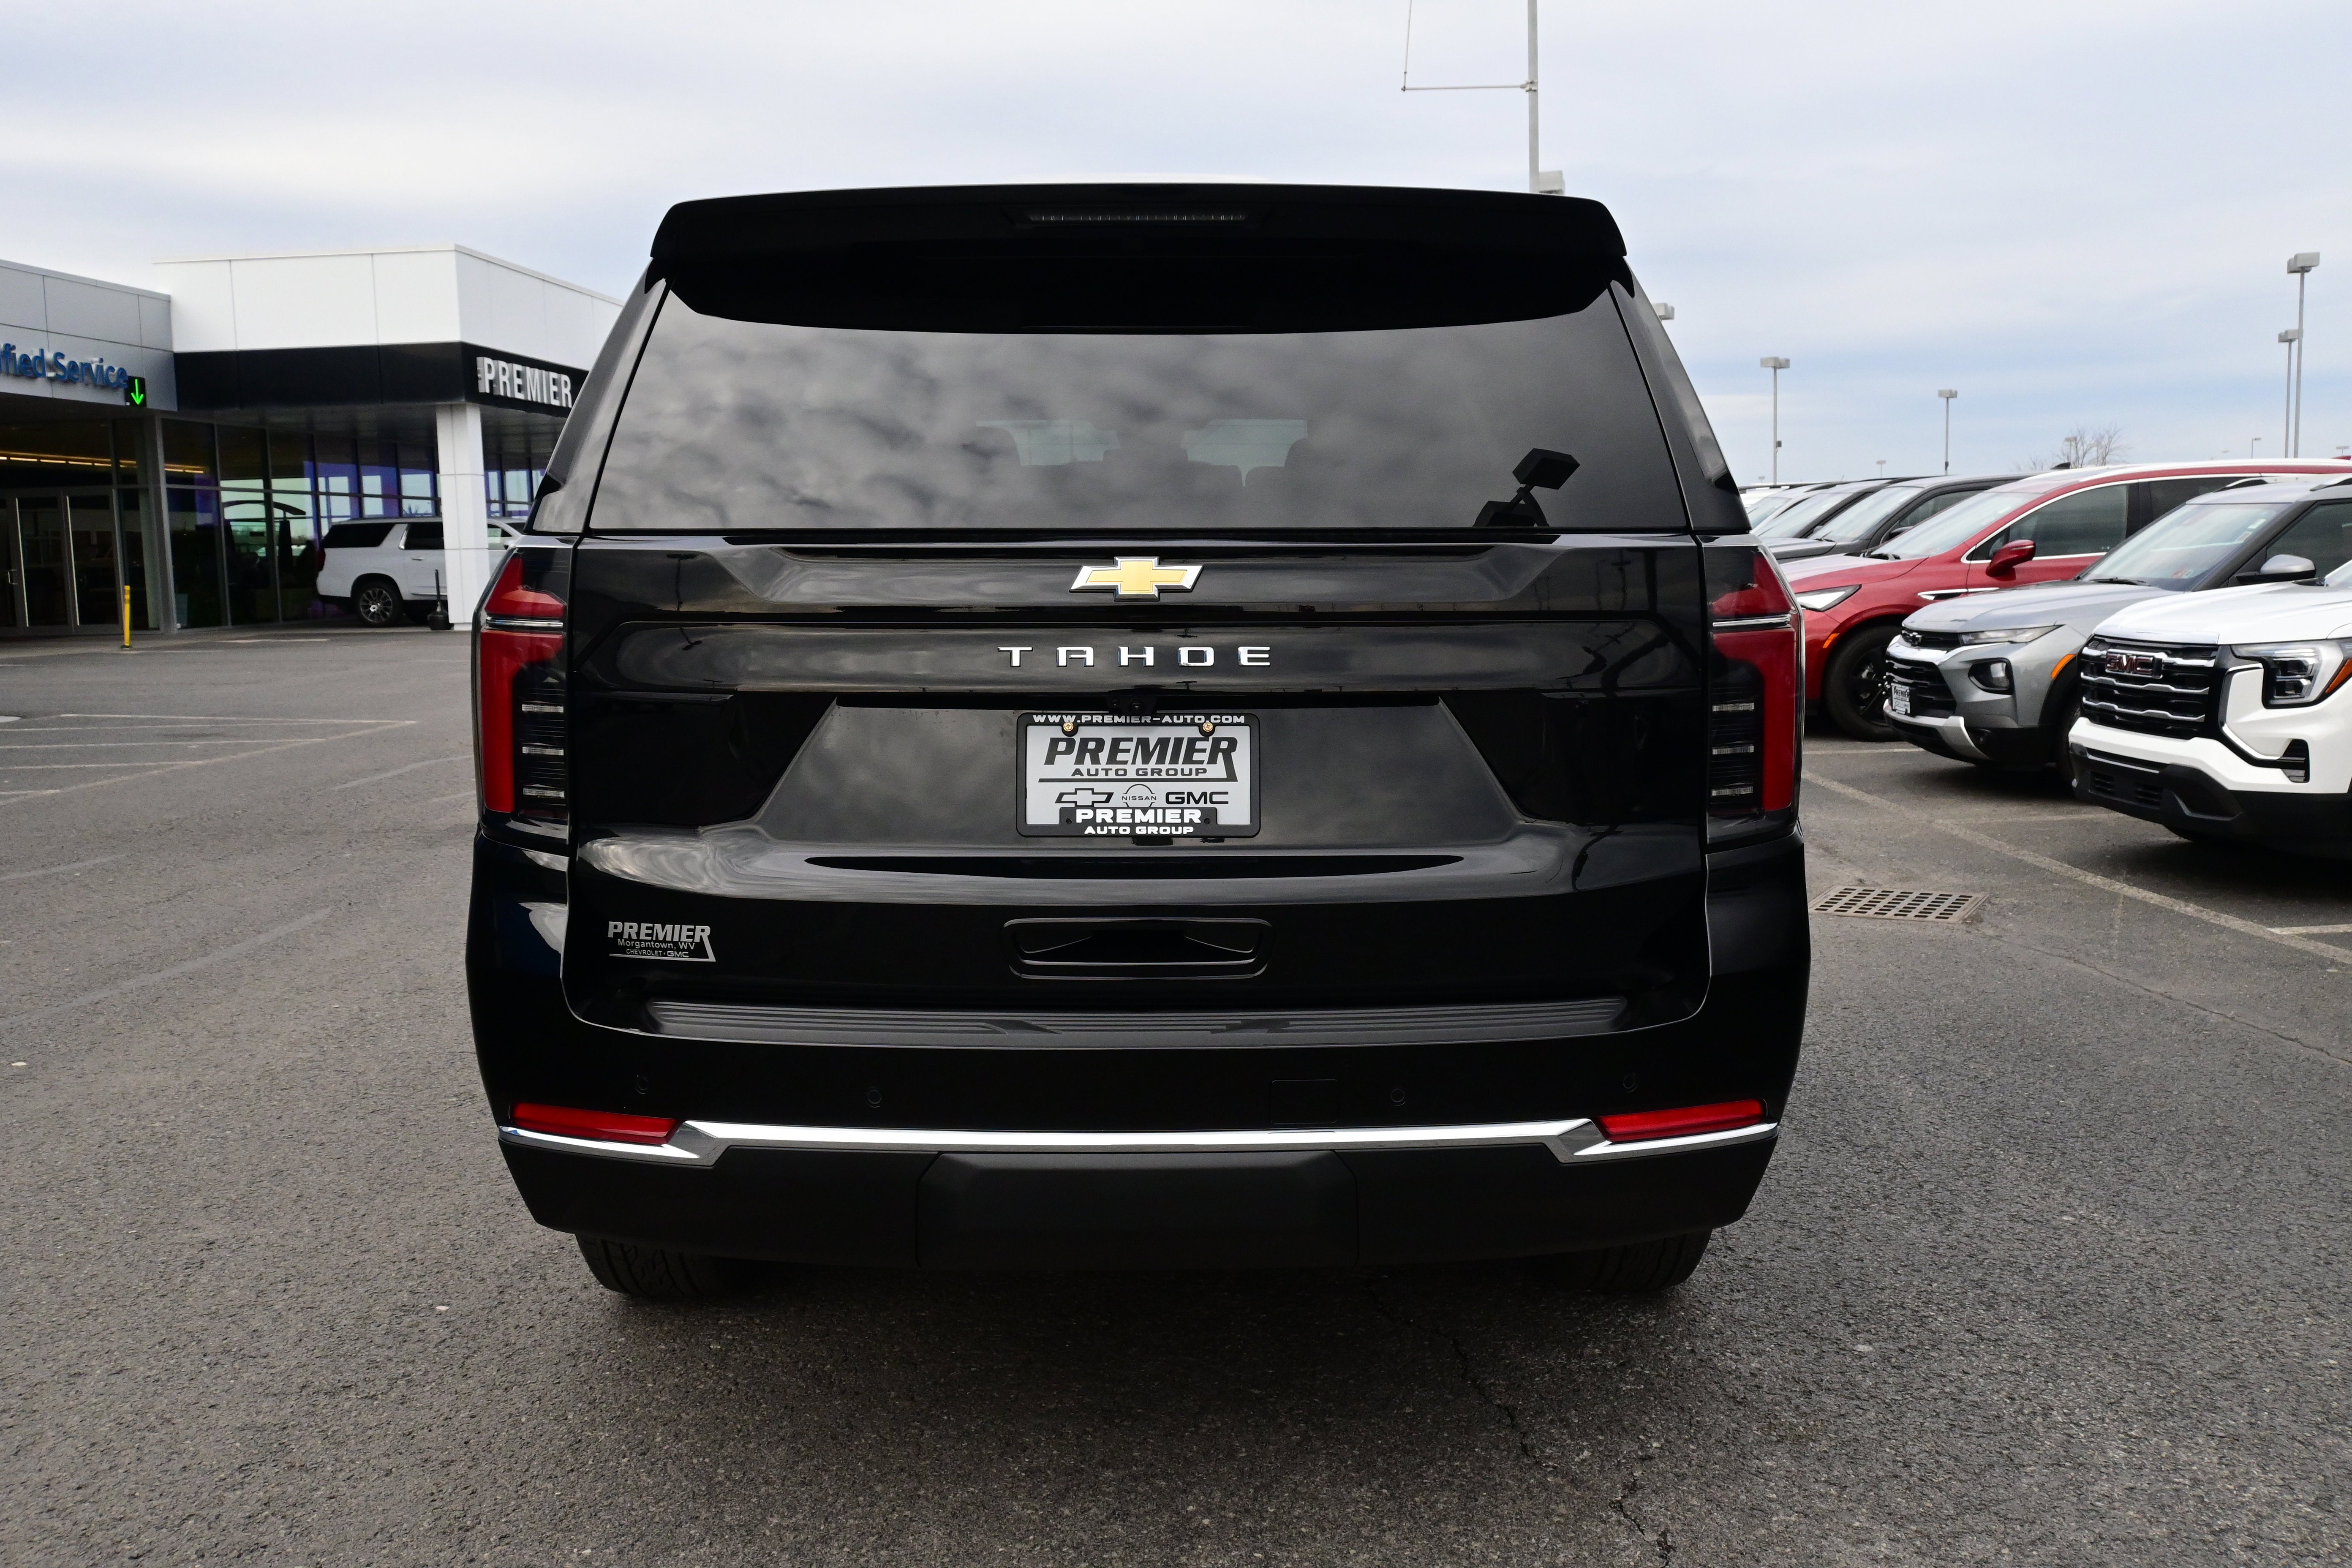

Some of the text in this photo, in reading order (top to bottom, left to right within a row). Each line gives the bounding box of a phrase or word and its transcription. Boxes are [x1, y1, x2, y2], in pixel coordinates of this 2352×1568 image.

[53, 352, 128, 388] Service
[480, 357, 572, 408] PREMIER
[997, 647, 1271, 667] TAHOE
[2105, 653, 2153, 675] GMC
[1032, 715, 1245, 723] WWW.PREMIER-AUTO.COM
[1044, 737, 1238, 766] PREMIER
[1071, 768, 1207, 776] AUTO GROUP
[1165, 792, 1229, 804] GMC
[1076, 809, 1201, 823] PREMIER
[1084, 826, 1194, 835] AUTO GROUP
[608, 921, 711, 943] PREMIER
[618, 939, 695, 950] Morgantown, WV
